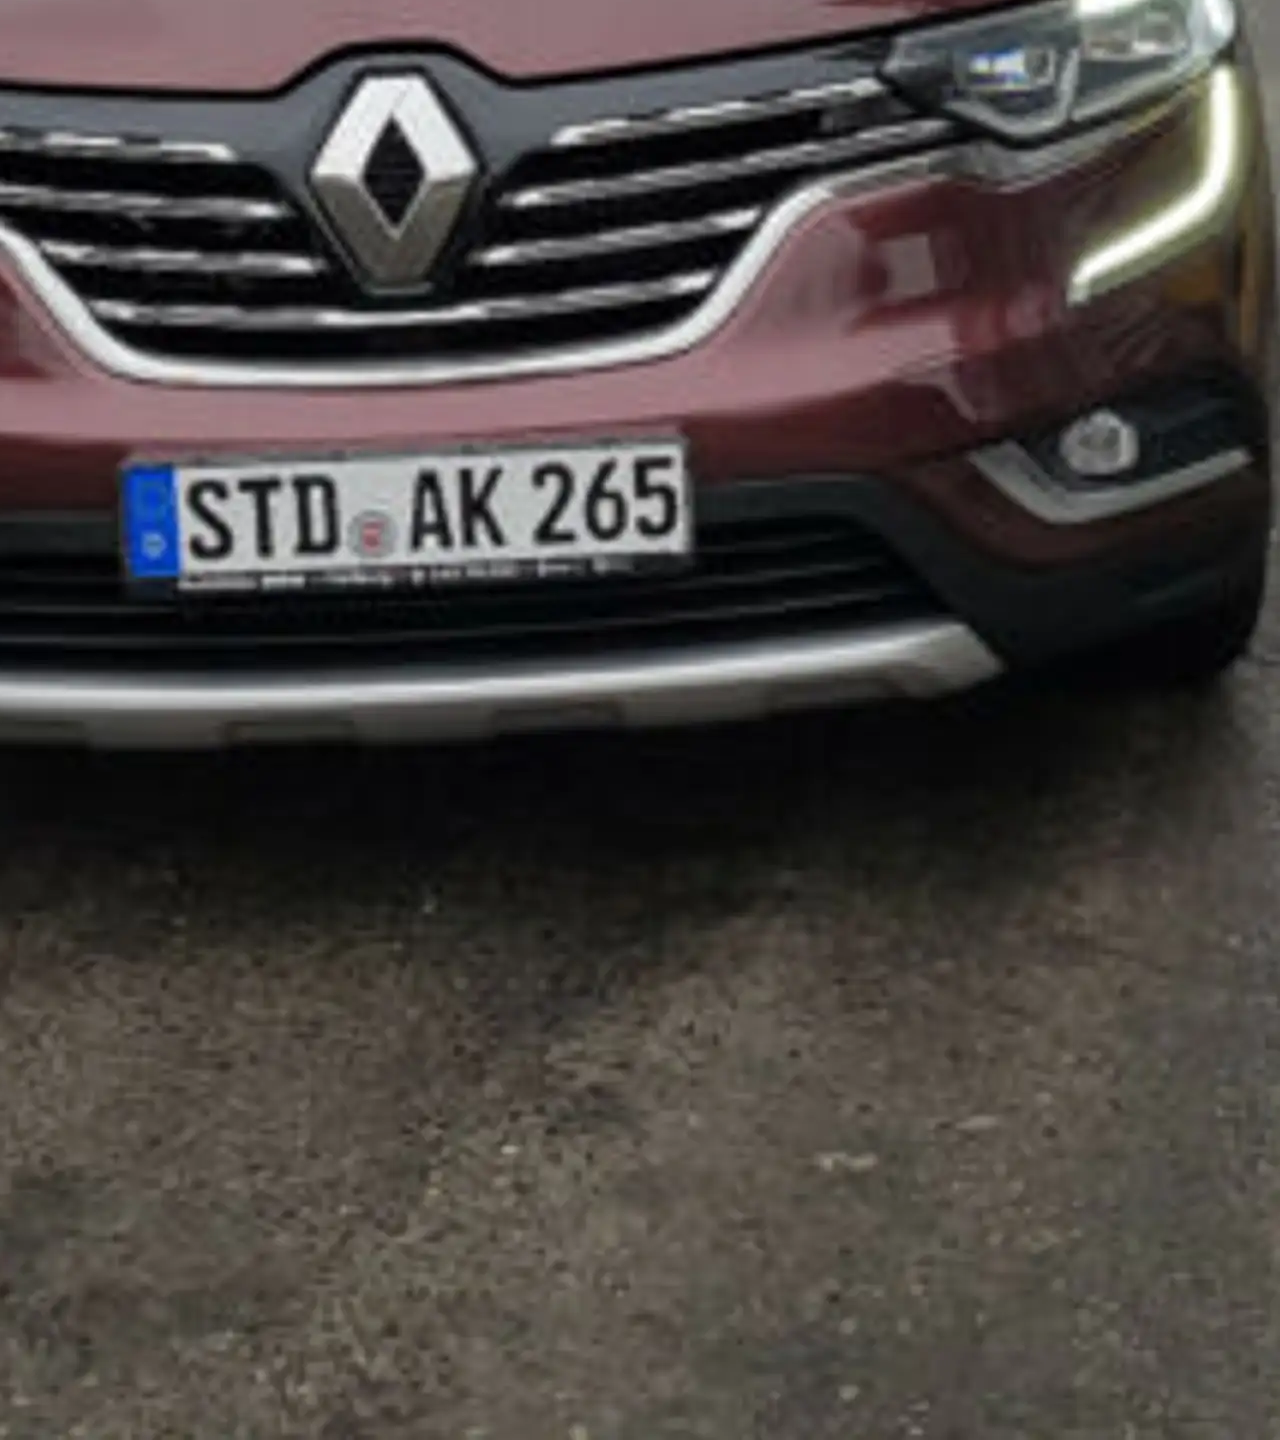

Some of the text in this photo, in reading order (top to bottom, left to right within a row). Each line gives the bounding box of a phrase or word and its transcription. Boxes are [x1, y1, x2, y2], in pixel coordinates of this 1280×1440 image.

[187, 456, 678, 561] STD AK 265
